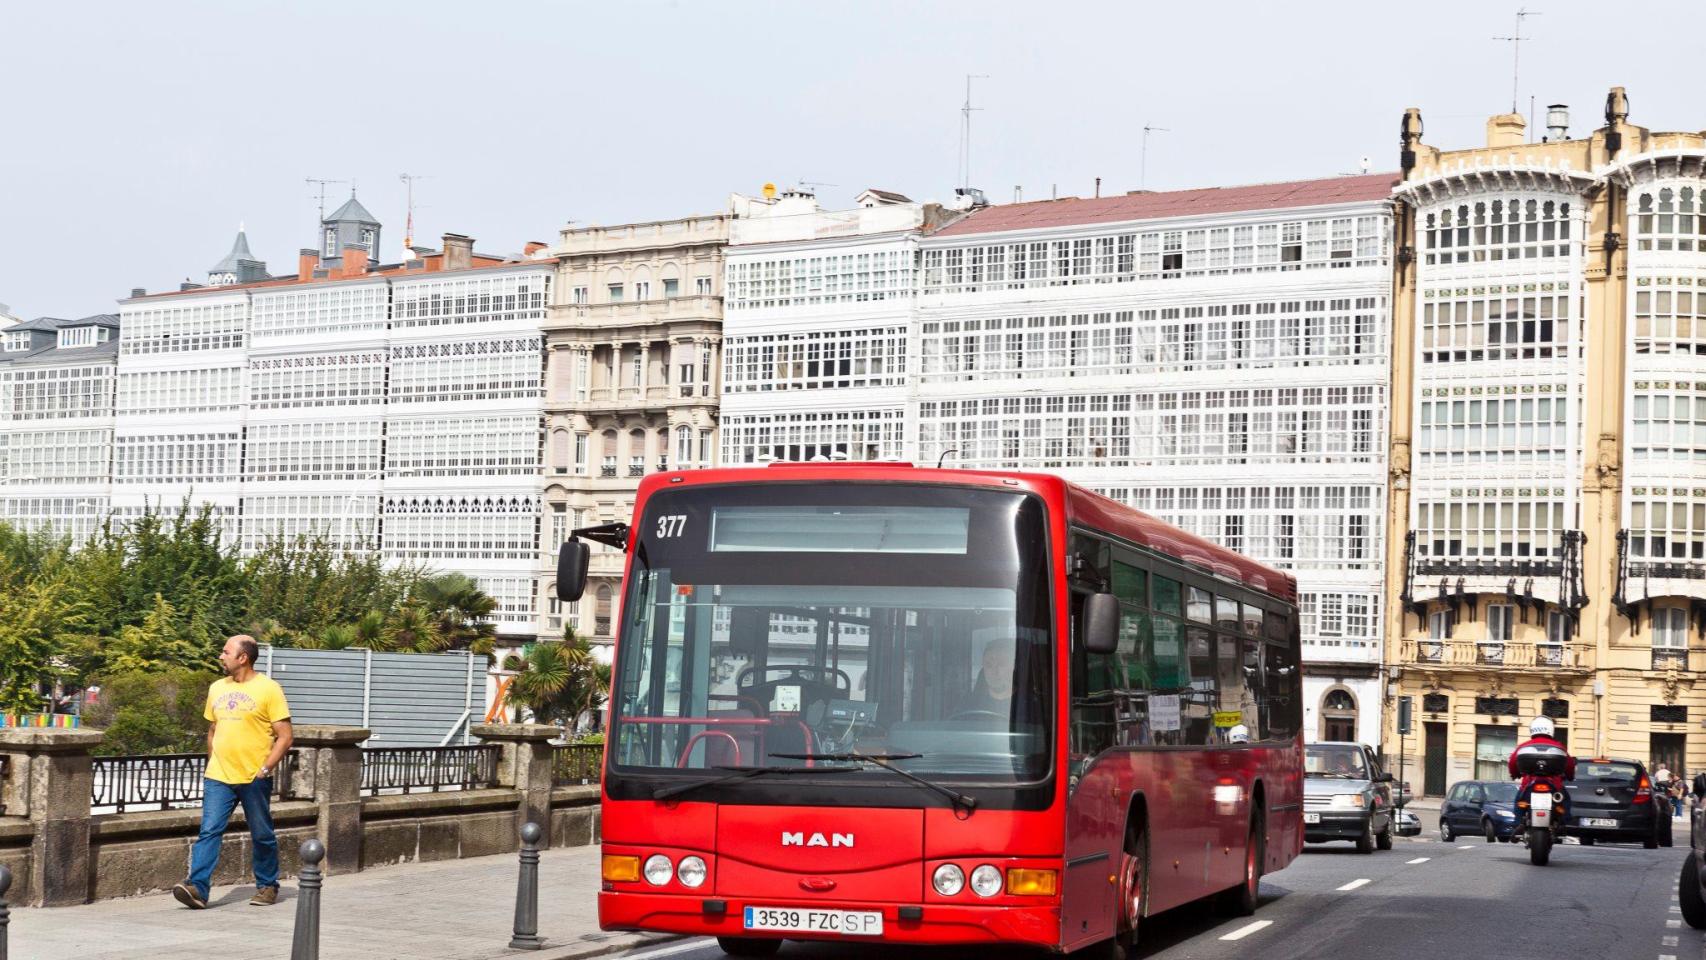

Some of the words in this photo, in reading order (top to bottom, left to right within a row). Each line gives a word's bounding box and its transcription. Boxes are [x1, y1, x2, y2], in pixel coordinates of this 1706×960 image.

[656, 515, 687, 539] 377
[782, 832, 854, 847] MAN
[759, 910, 800, 927] 3539
[808, 912, 839, 930] FZC
